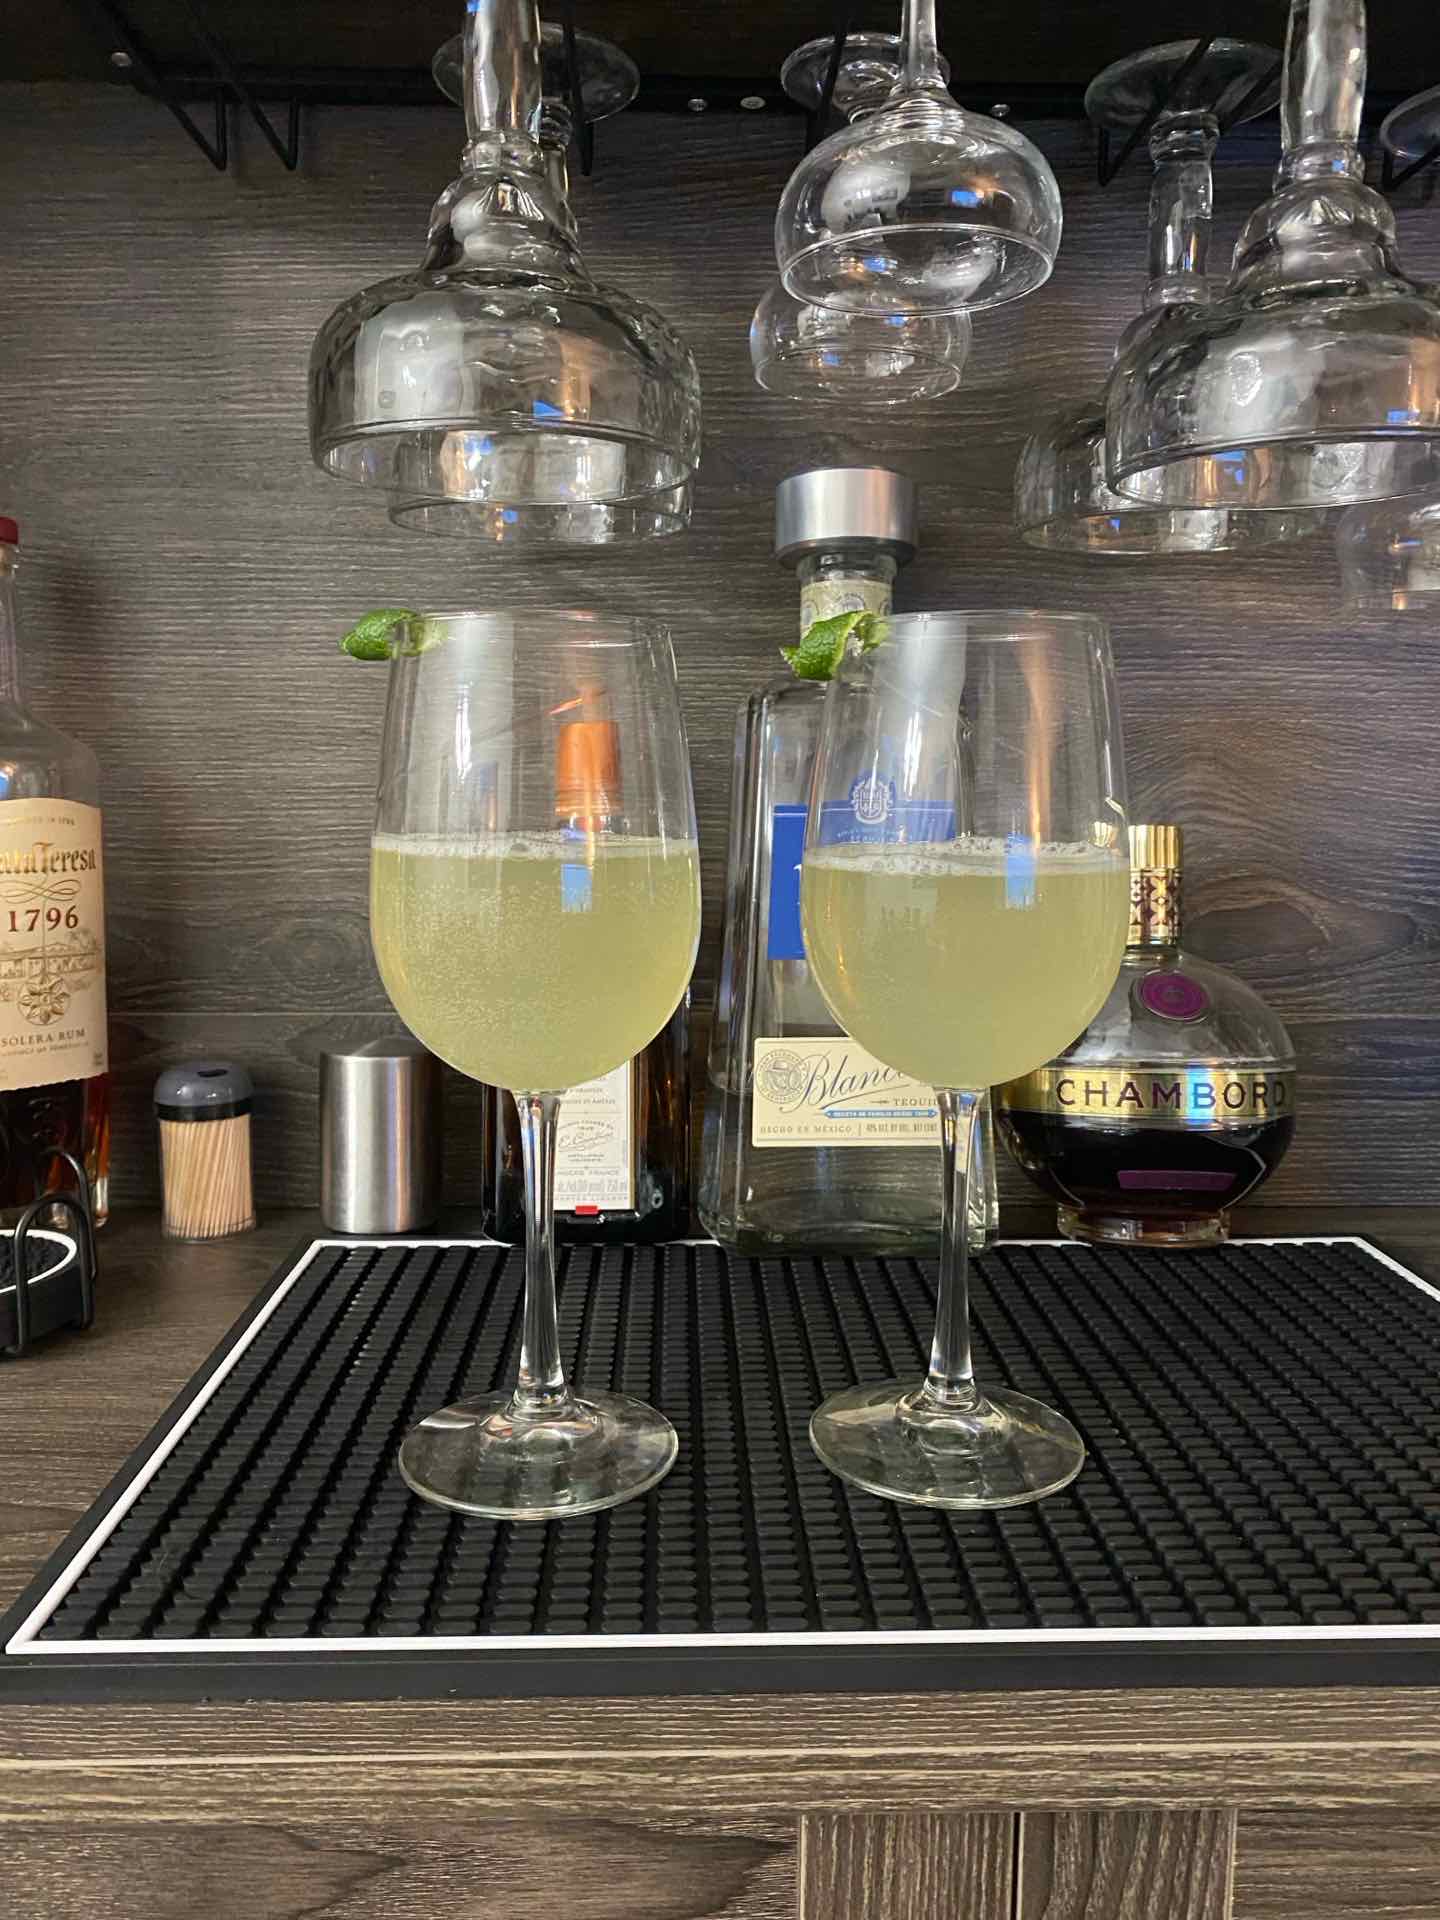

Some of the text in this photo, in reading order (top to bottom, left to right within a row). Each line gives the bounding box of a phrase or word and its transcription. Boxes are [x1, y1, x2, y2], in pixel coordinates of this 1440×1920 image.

[8, 904, 79, 932] 1796
[1, 1027, 86, 1047] SOLERA RUM
[1055, 1078, 1286, 1110] CHAMBORD
